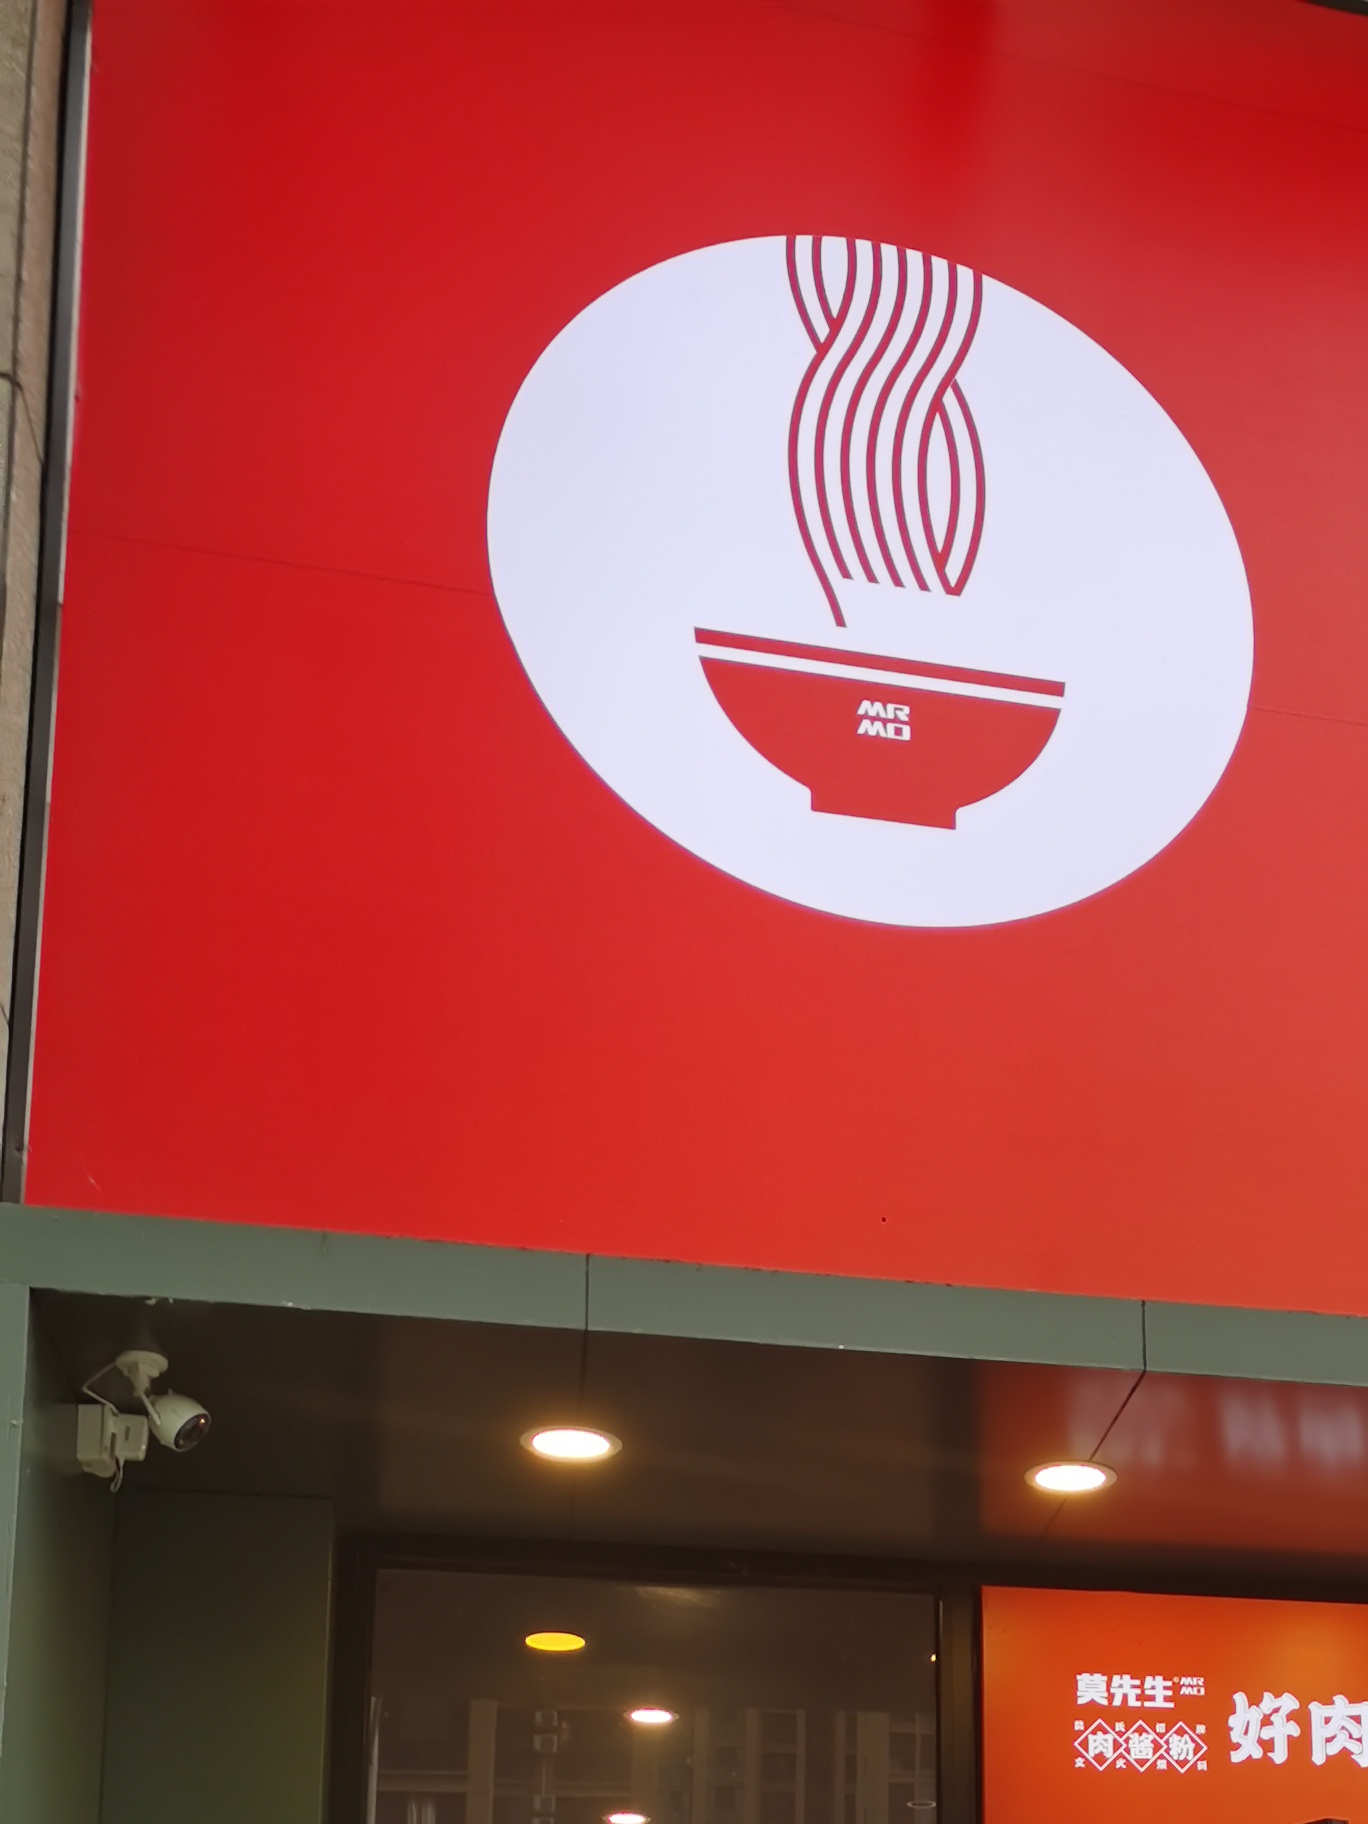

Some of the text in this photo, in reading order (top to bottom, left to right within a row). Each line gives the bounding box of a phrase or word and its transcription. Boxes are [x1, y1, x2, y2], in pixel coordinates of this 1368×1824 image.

[857, 700, 911, 721] MR
[857, 722, 911, 741] MO
[1076, 1673, 1175, 1708] 莫先生
[1087, 1731, 1196, 1760] 肉酱粉
